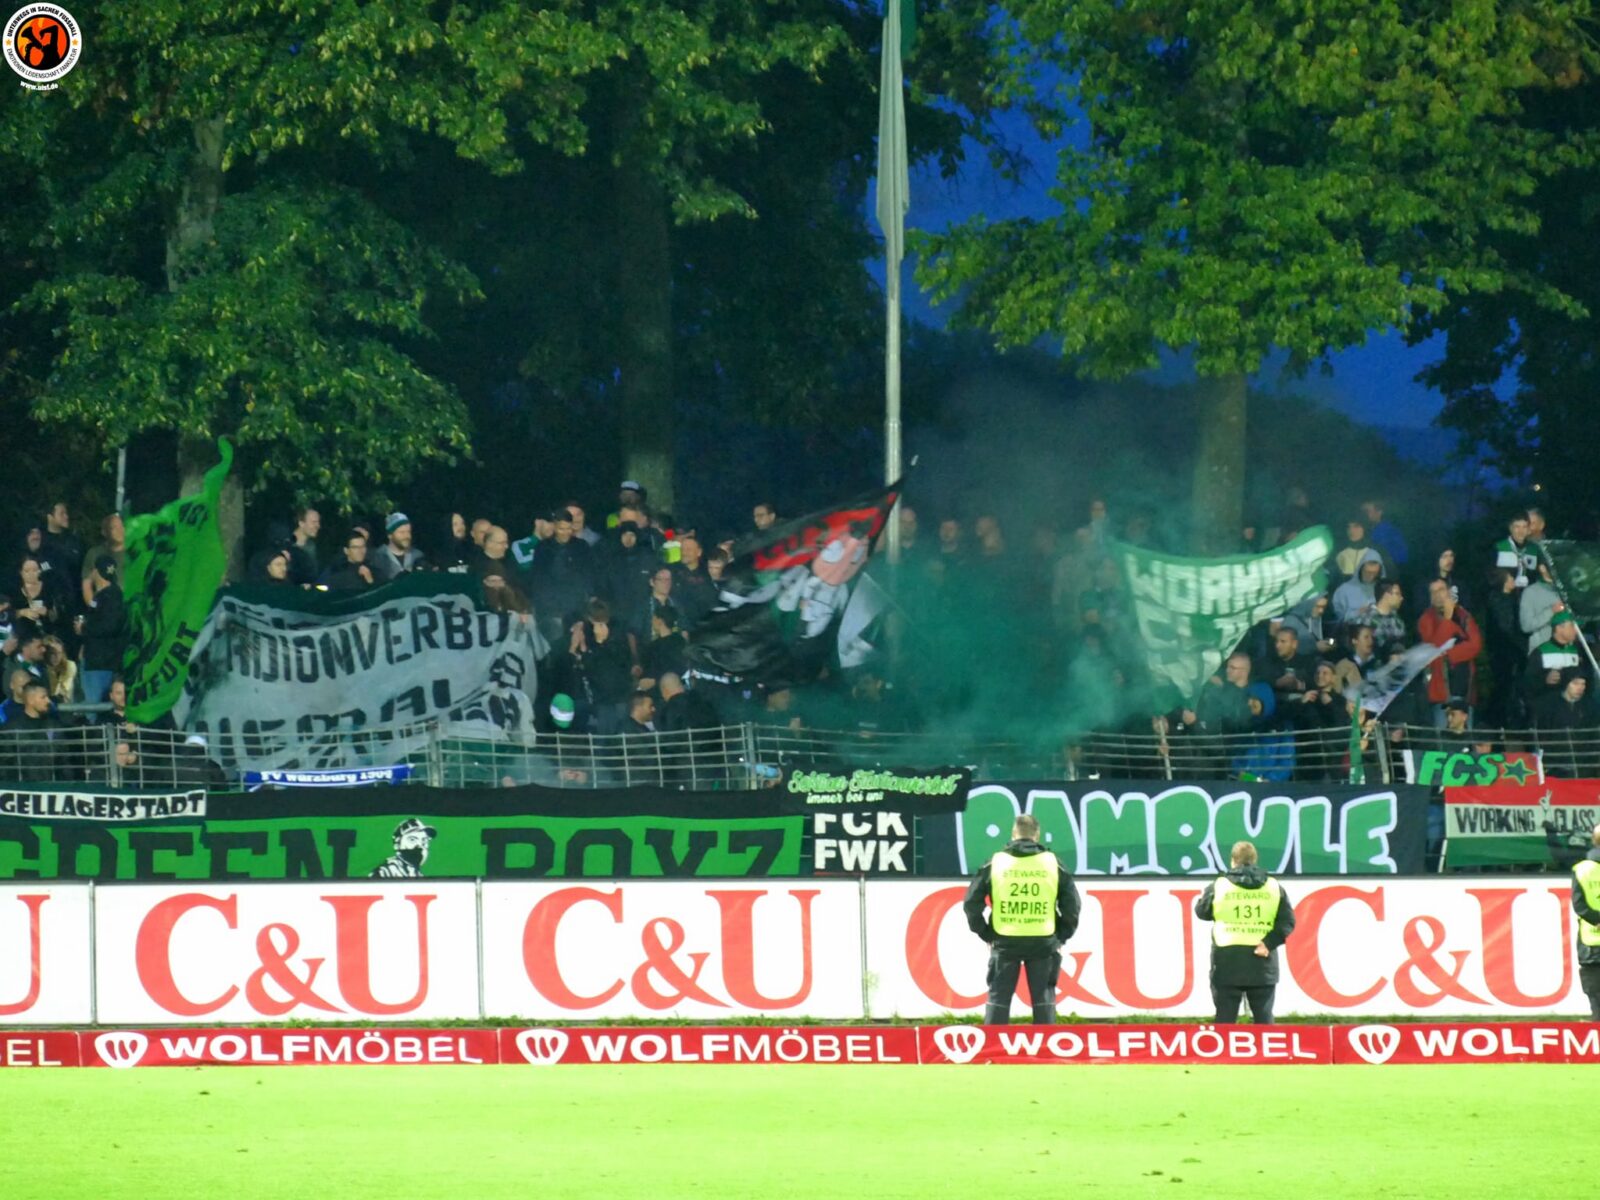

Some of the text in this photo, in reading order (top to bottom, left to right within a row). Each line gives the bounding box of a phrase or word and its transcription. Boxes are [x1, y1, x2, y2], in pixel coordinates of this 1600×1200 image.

[1417, 751, 1505, 786] FCS
[1454, 806, 1536, 834] WORKING
[814, 838, 908, 872] FWK
[1003, 869, 1048, 878] STEWARD
[1010, 882, 1040, 897] 240
[1000, 901, 1048, 915] EMPIRE
[1224, 892, 1271, 901] STEWARD
[1233, 904, 1262, 919] 131
[135, 892, 437, 1017] C&U
[522, 886, 821, 1011] C&U
[1285, 885, 1572, 1008] C&U
[160, 1031, 483, 1065] WOLFMÖBEL
[581, 1028, 901, 1063] WOLFMÖBEL
[998, 1025, 1317, 1060] WOLFMÖBEL
